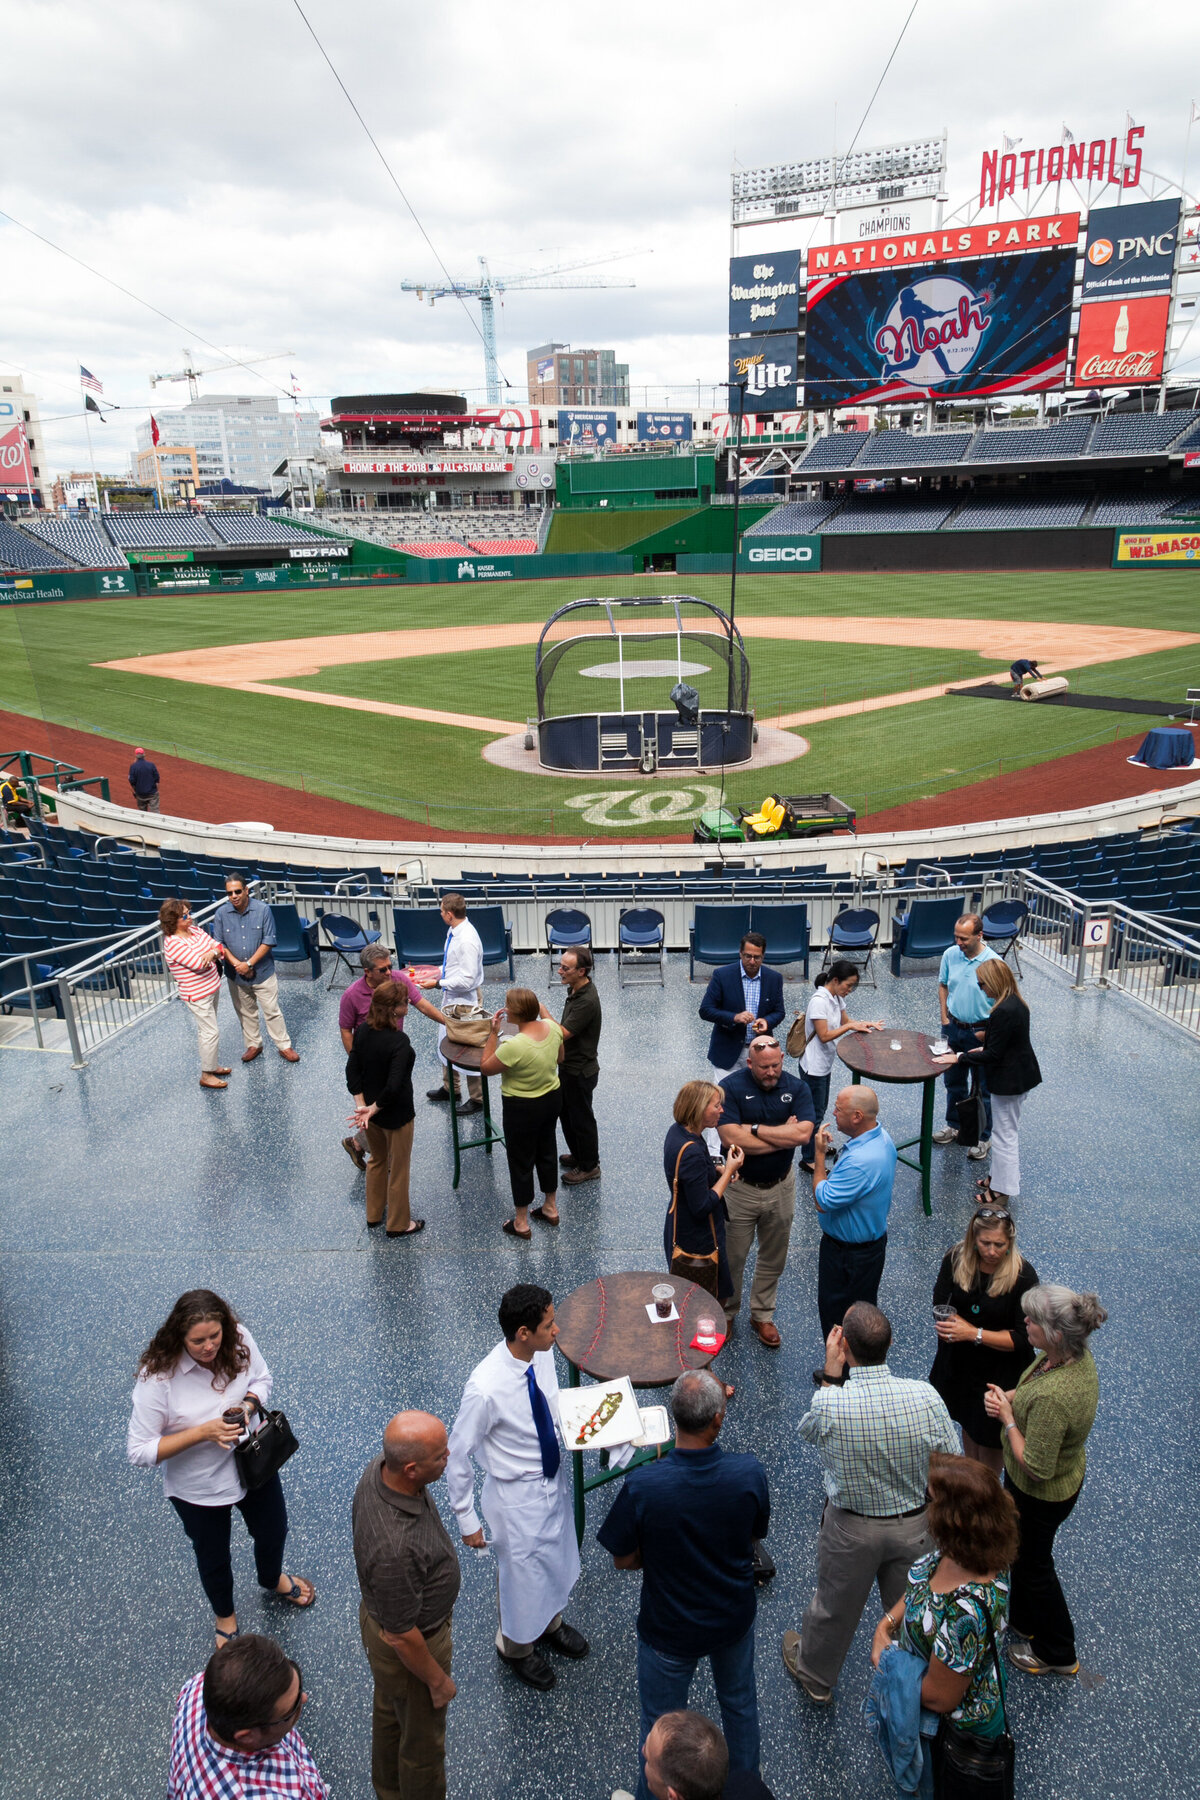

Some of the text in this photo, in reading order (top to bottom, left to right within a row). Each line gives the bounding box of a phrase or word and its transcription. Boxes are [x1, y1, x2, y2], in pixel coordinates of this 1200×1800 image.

[980, 126, 1145, 208] NATIONALS
[859, 216, 911, 237] CHAMPIONS
[816, 221, 1063, 269] NATIONALS PARK
[1117, 233, 1174, 260] PNC
[753, 264, 775, 280] The
[1086, 273, 1170, 289] Official Bank of the Nationals
[731, 281, 797, 301] Washington
[750, 302, 776, 322] Post
[875, 295, 991, 363] Noah
[745, 363, 792, 396] Lite
[350, 463, 374, 473] HOME
[376, 463, 387, 473] OF
[389, 463, 404, 473] THE
[406, 463, 427, 473] 2018
[484, 462, 506, 472] GAME
[391, 476, 412, 486] RED
[320, 547, 349, 557] FAN
[748, 547, 812, 562] GEICO
[0, 588, 64, 601] MedStar Health
[1090, 924, 1103, 942] C
